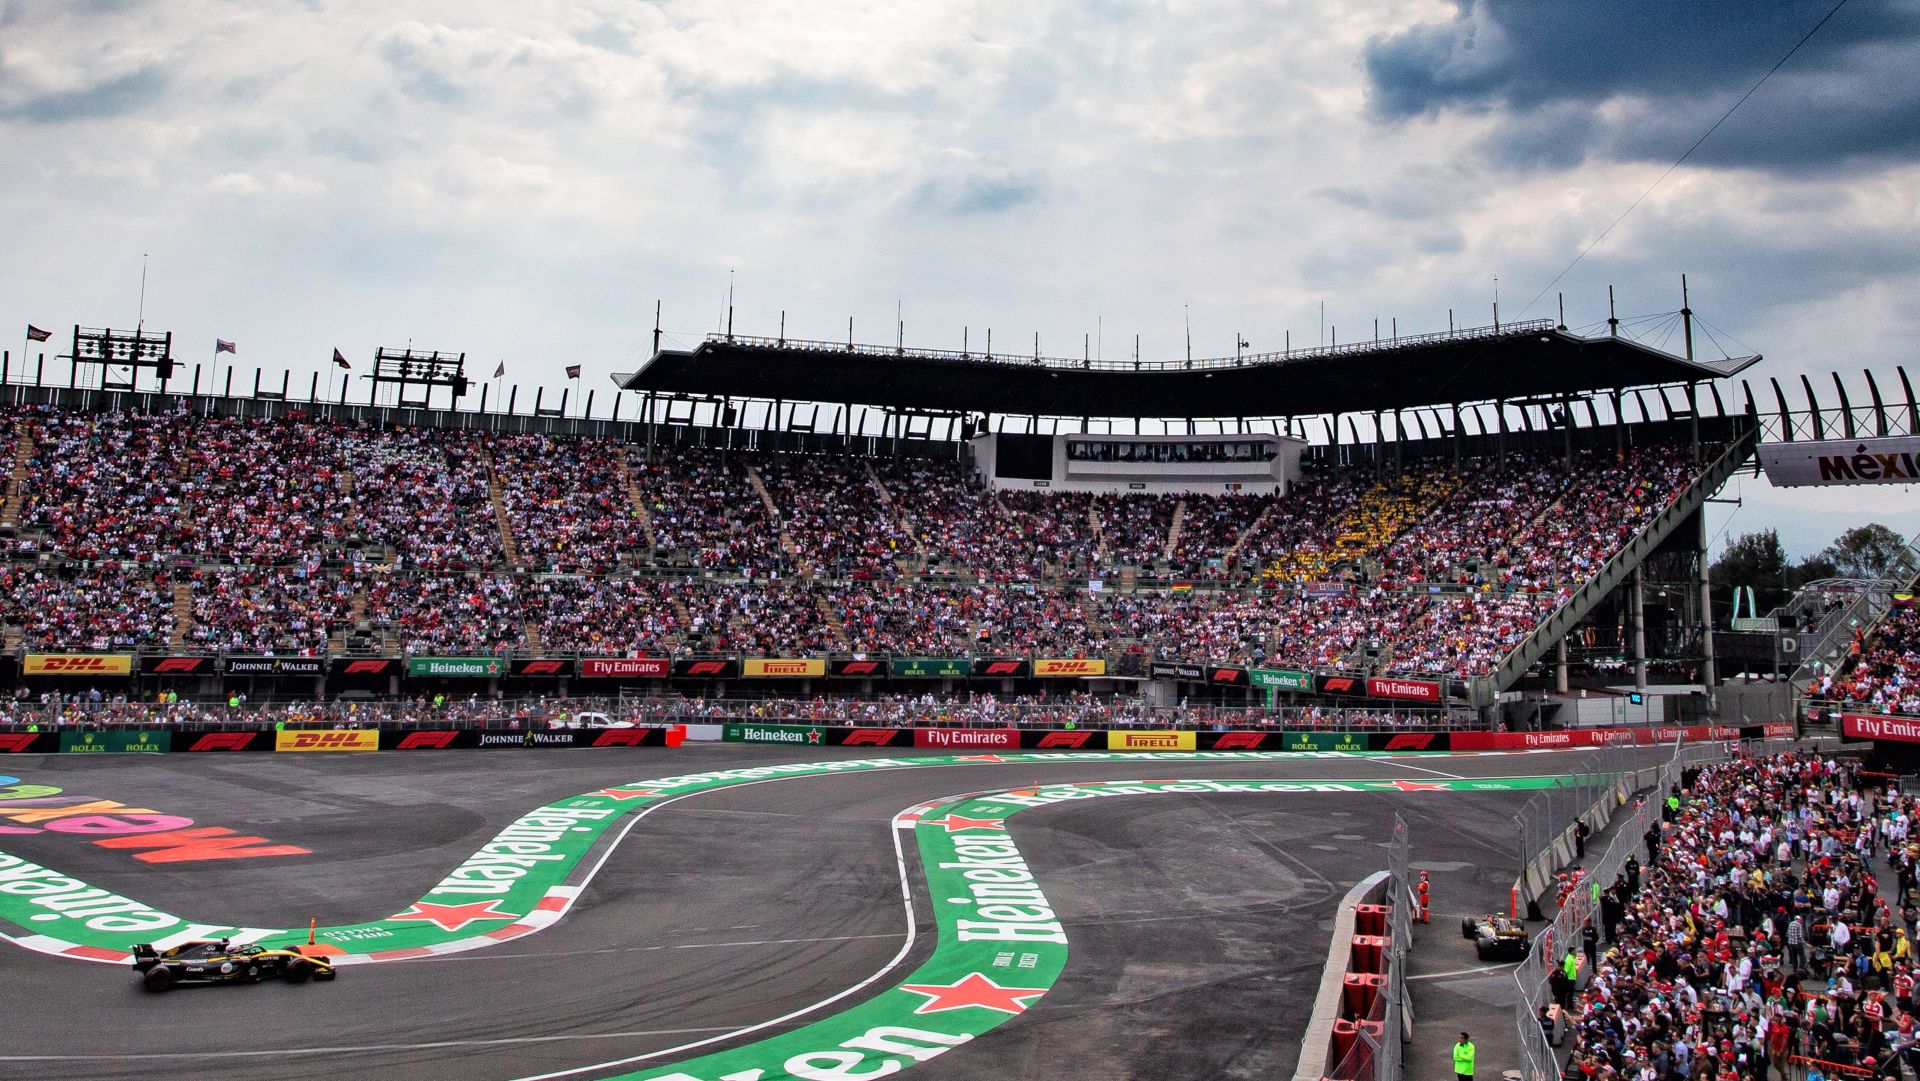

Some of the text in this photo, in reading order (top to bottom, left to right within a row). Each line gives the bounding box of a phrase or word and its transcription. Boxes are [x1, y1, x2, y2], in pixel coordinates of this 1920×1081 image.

[1782, 637, 1797, 653] D
[42, 658, 106, 670] DHL
[230, 661, 319, 672] JOHNNIE WALKER
[430, 662, 483, 673] Heineken
[594, 661, 660, 673] Fly Emirates
[763, 662, 807, 673] PIRELLI
[1047, 661, 1090, 673] DHL
[1178, 668, 1200, 677] WALKER
[1262, 674, 1298, 687] Heineken
[1376, 681, 1429, 696] Fly Emirates
[1856, 718, 1880, 736] Fly
[294, 733, 363, 747] DHL
[480, 733, 573, 746] JOHNNIE WALKER
[743, 728, 803, 742] Heineken
[928, 731, 1007, 745] Fly Emirates
[1126, 734, 1178, 747] PIRELLI
[1526, 733, 1570, 746] Fly Emirates
[70, 744, 105, 752] ROLEX
[126, 743, 160, 751] ROLEX
[1335, 743, 1361, 751] ROLEX
[625, 758, 920, 789] Heineken
[975, 782, 1365, 807] Heineken
[430, 805, 615, 895] Heineken
[938, 834, 1069, 944] Heineken
